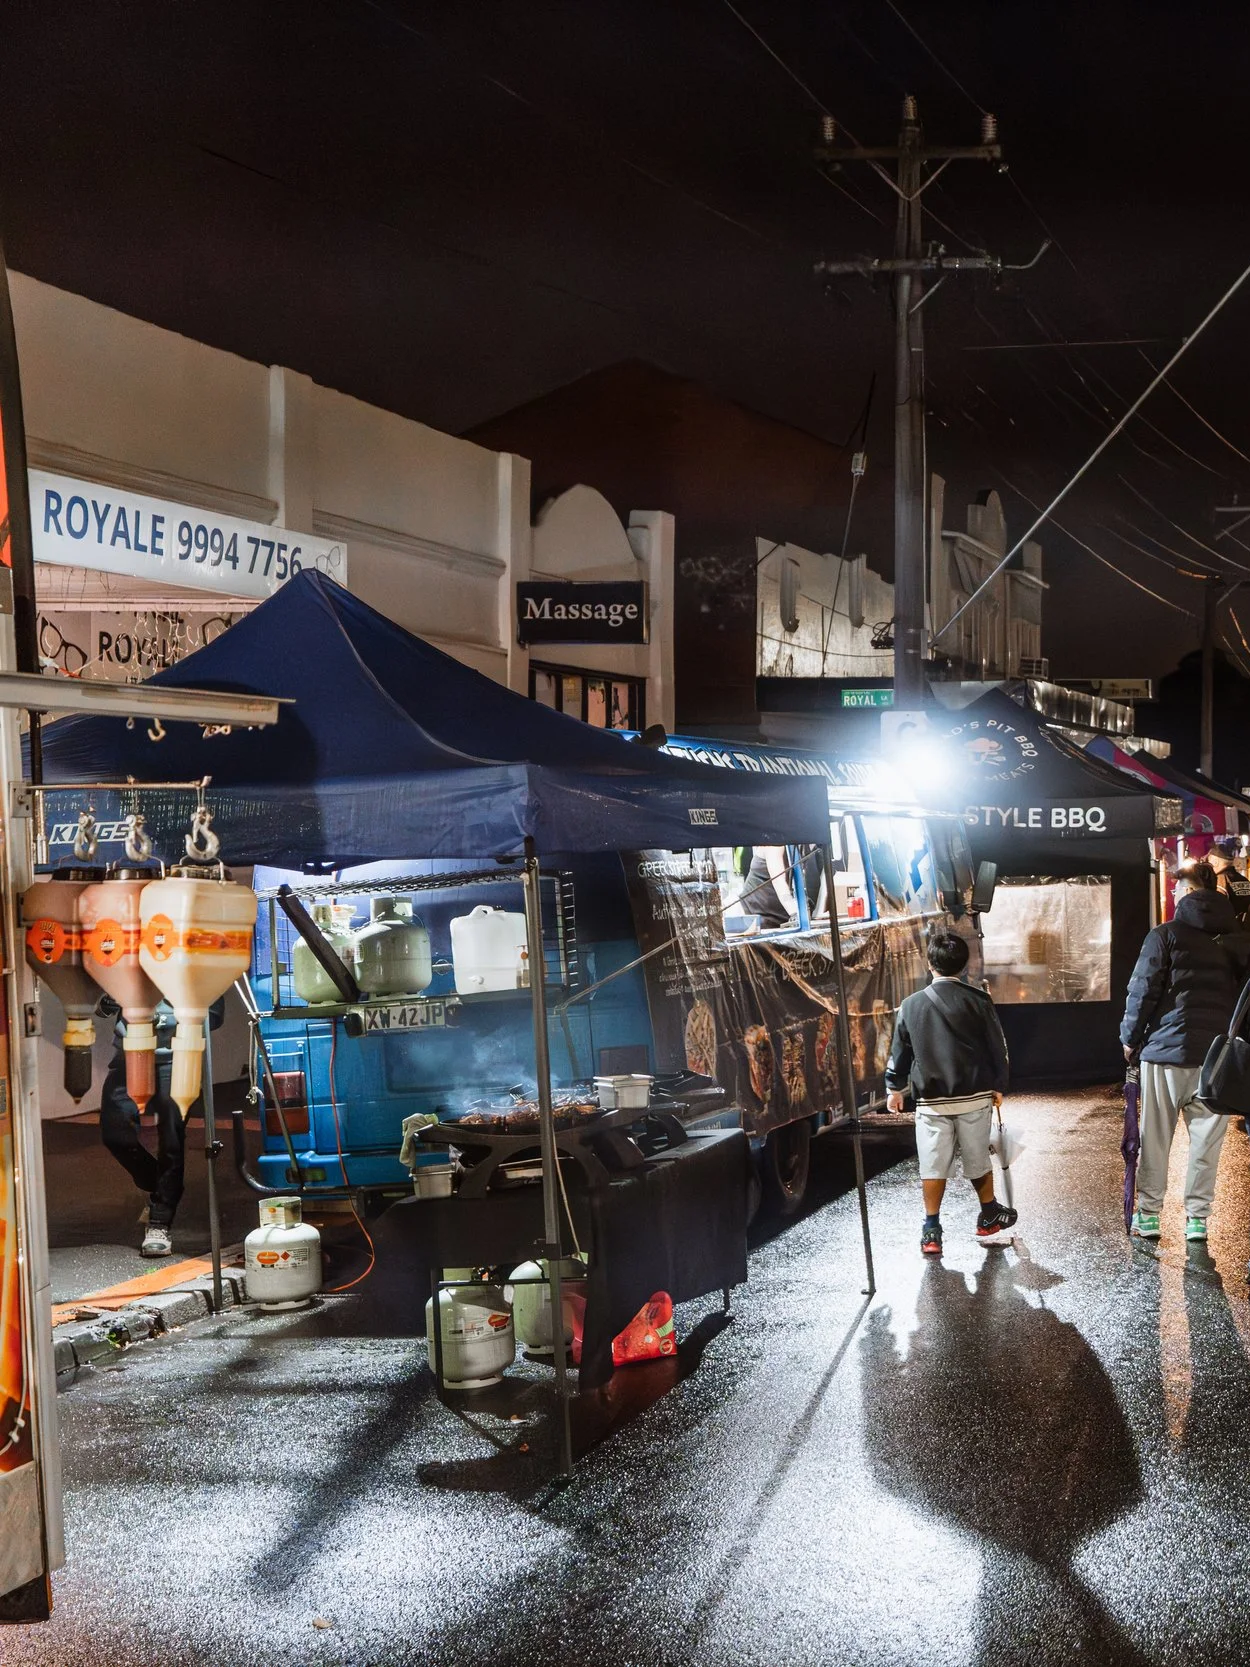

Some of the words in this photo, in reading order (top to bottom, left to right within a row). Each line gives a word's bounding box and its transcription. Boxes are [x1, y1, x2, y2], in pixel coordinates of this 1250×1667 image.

[43, 489, 165, 556] ROYALE
[177, 520, 240, 571] 9994
[247, 536, 302, 580] 7756
[523, 597, 639, 627] Massage
[843, 695, 877, 706] ROYAL
[986, 719, 1015, 734] PIT
[1014, 735, 1039, 757] BBQ
[689, 809, 718, 824] KINGS
[964, 805, 1043, 828] STYLE
[1050, 806, 1107, 832] BBQ
